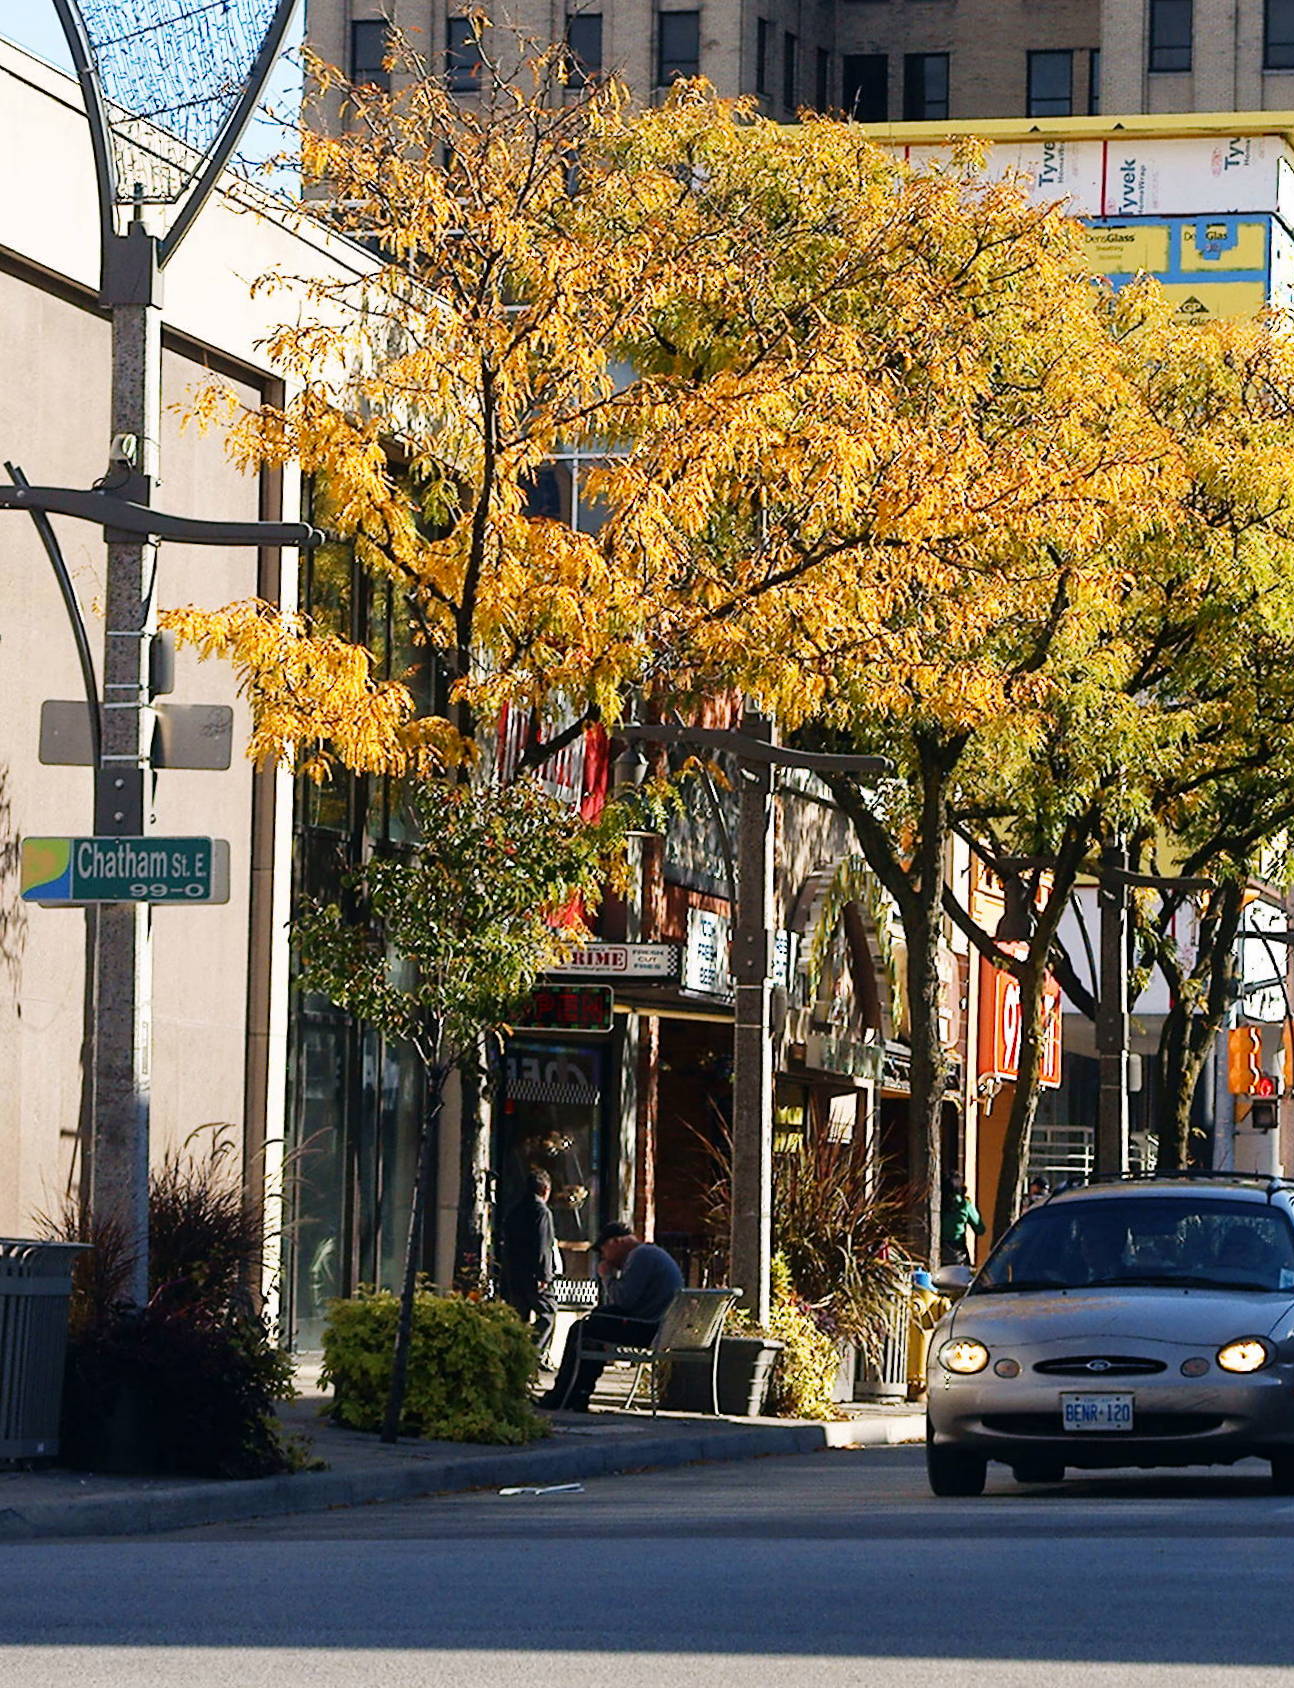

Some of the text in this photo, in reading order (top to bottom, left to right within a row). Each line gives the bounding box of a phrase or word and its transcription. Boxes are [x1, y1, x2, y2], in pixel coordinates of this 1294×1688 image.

[1039, 140, 1058, 187] Tyve
[1119, 159, 1138, 215] Tyvek
[1085, 231, 1135, 243] DensGlass
[1183, 301, 1201, 312] GP
[77, 841, 207, 879] Chatham St. E.
